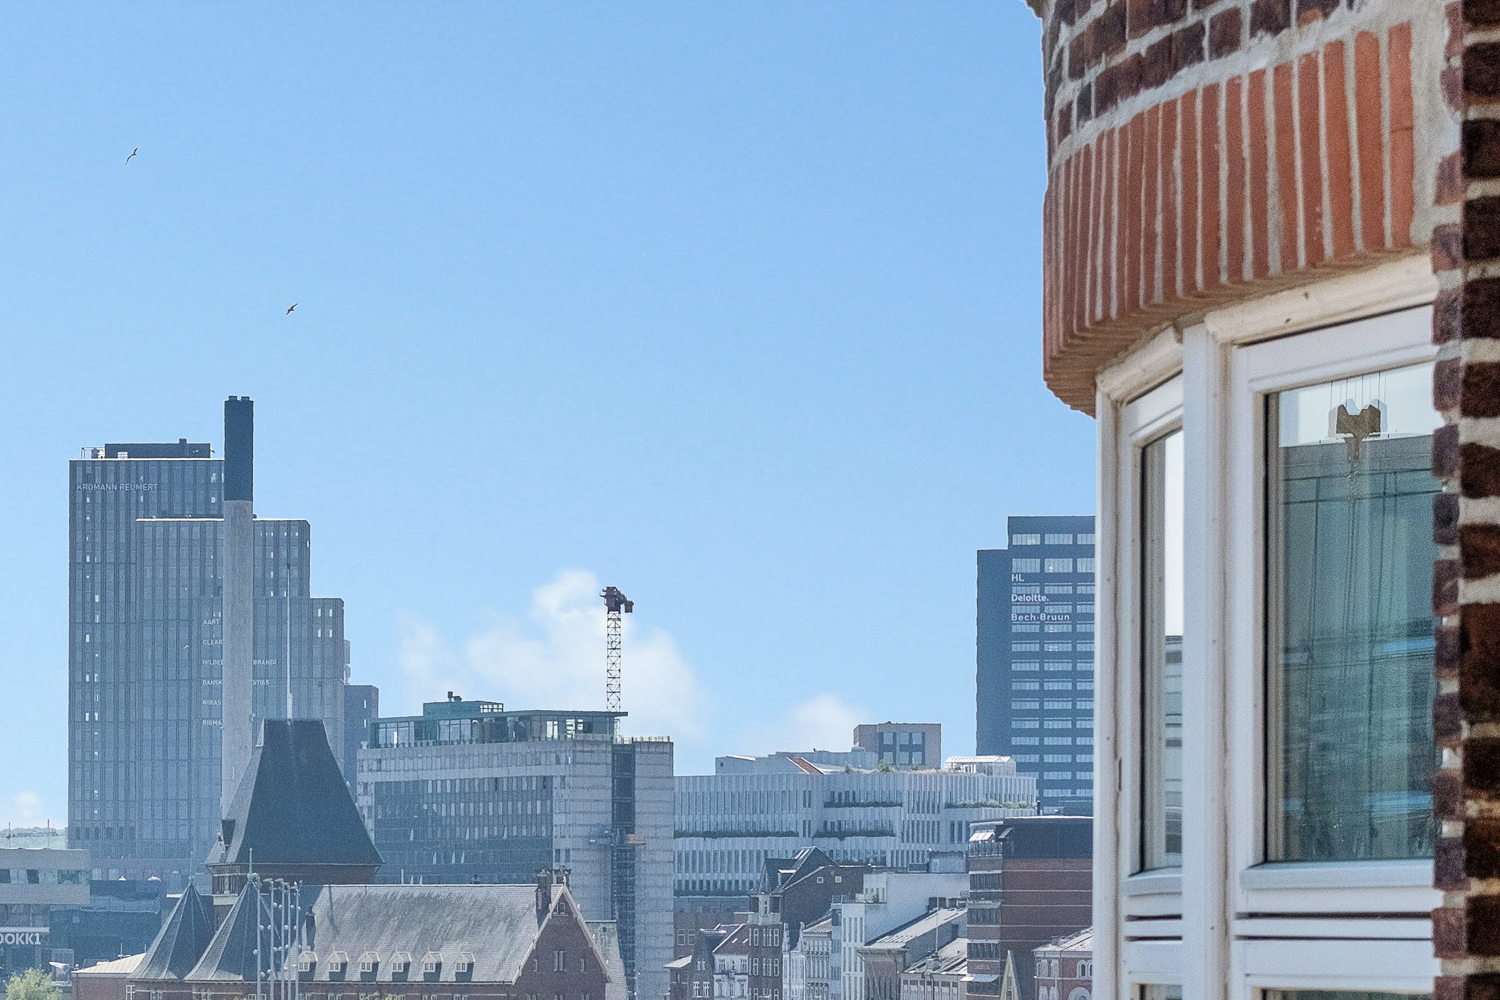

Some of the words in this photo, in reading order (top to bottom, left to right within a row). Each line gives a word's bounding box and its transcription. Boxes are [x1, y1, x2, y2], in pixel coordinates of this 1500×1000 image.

[76, 483, 117, 491] KROMANN
[119, 483, 159, 491] REUMERT
[1011, 573, 1025, 582] HL
[1011, 593, 1050, 602] Deloitte.
